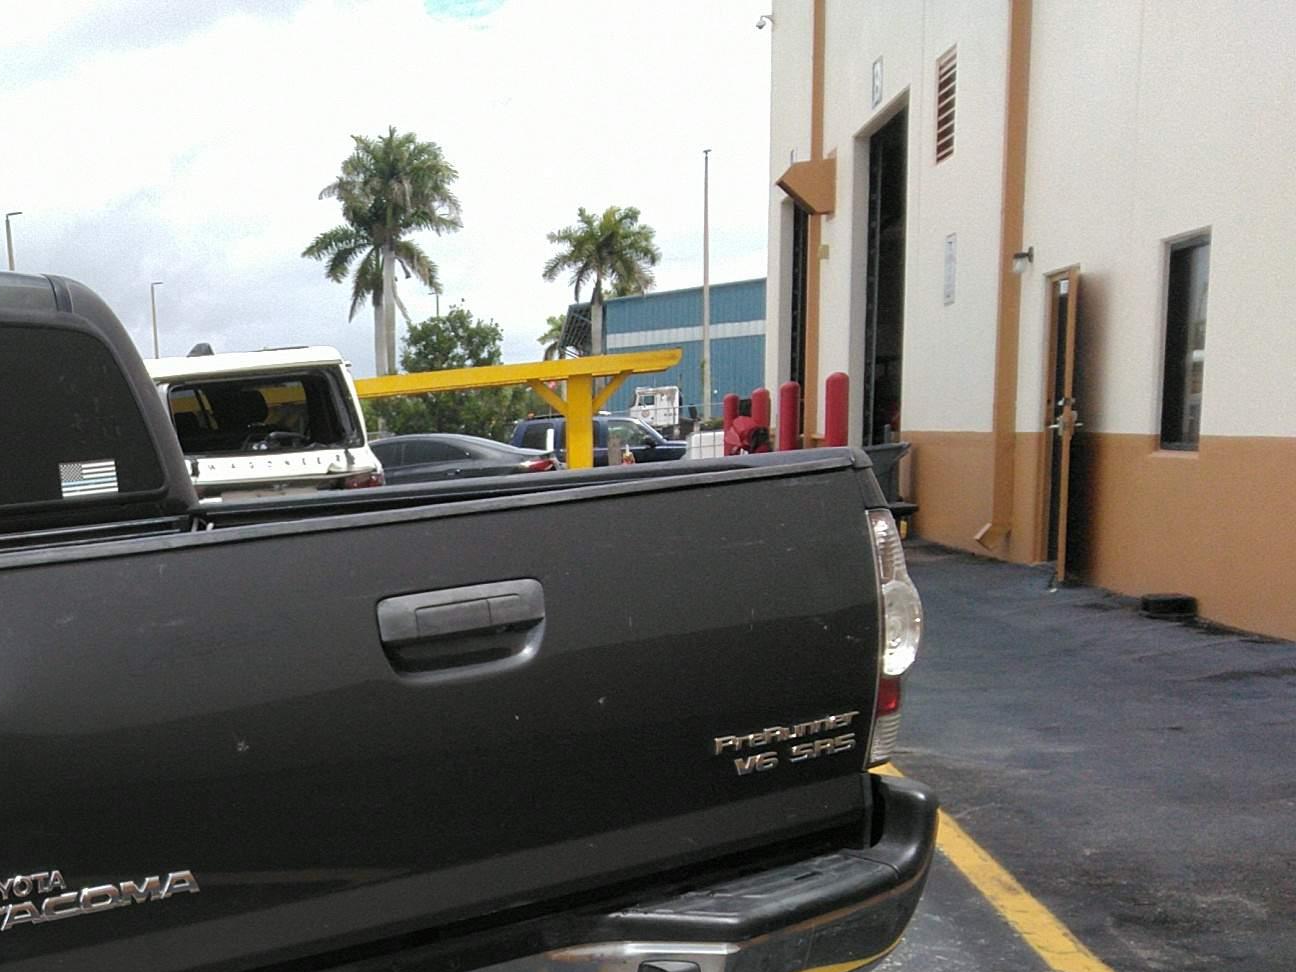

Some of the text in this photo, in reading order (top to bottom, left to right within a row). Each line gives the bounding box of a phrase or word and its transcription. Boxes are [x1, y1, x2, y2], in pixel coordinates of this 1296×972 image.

[714, 710, 861, 756] PreRunner
[734, 732, 857, 776] V6 SR5
